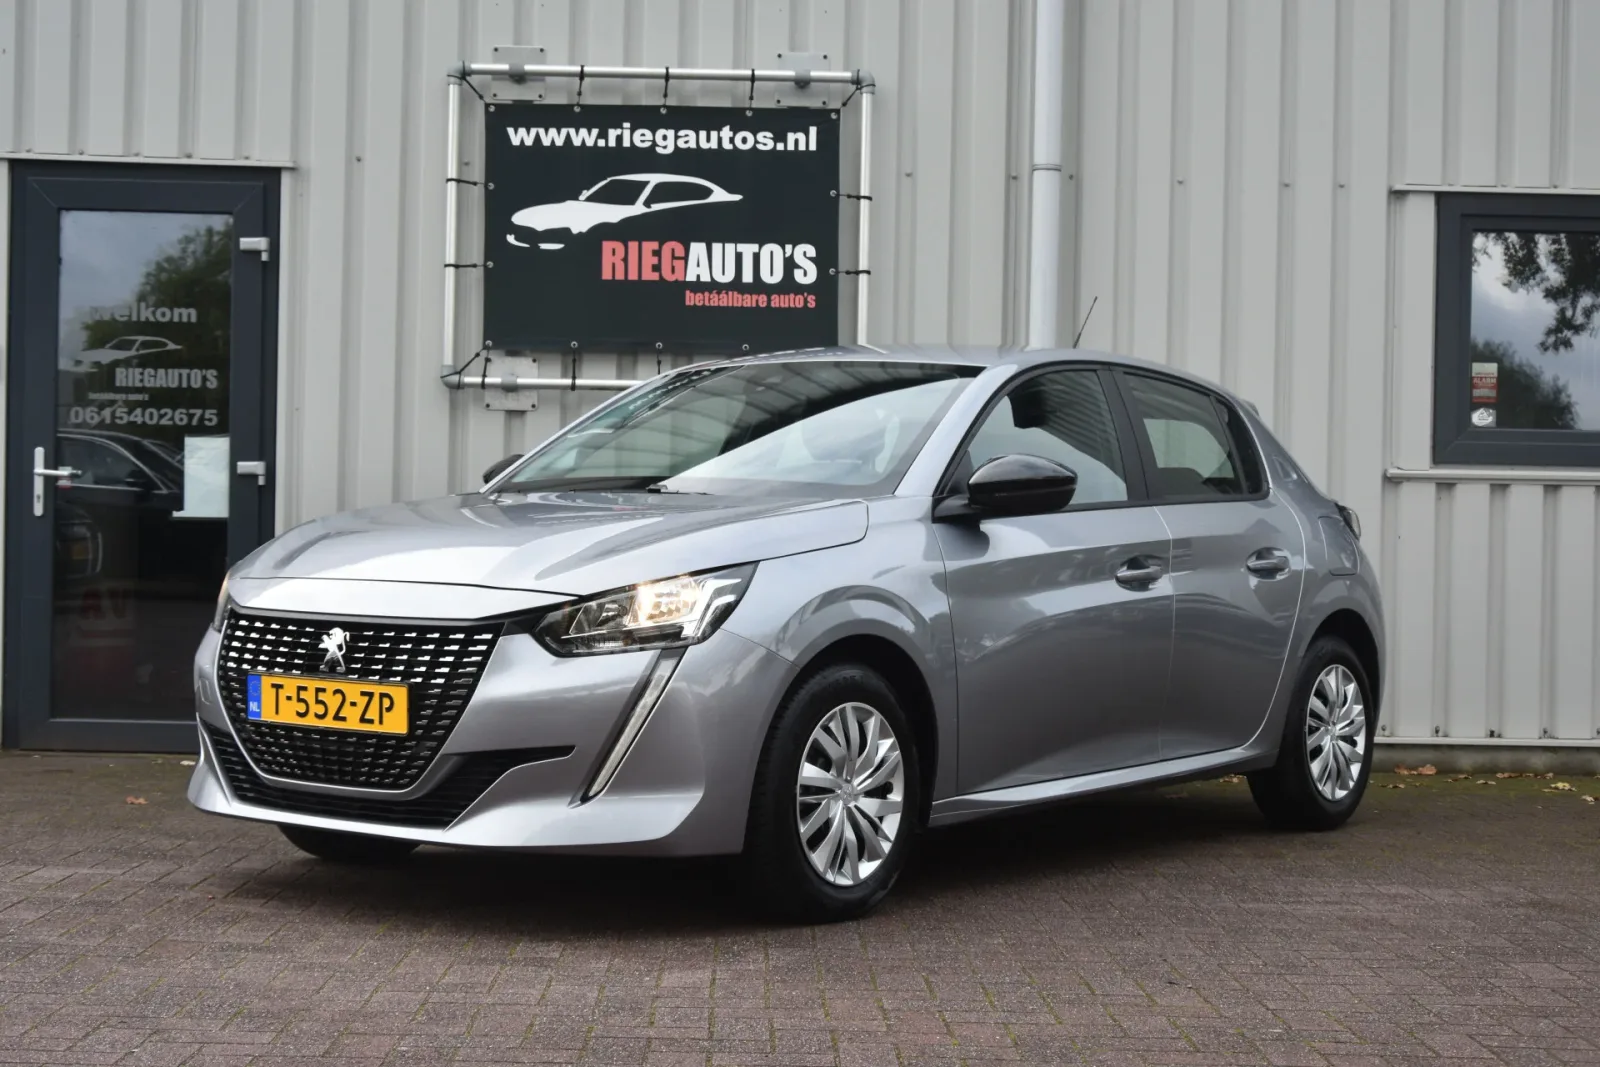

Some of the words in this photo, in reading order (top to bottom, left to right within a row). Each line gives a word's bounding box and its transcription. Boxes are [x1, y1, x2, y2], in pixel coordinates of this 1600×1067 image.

[506, 122, 818, 154] www.riegautos.nl
[601, 240, 818, 285] RIEGAUTO'S
[685, 290, 767, 308] betáálbare
[771, 292, 816, 309] auto's
[115, 367, 218, 389] RIEGAUTO'S
[69, 406, 218, 427] 0615402675
[249, 701, 260, 712] NL
[270, 683, 395, 725] T-552-ZP
